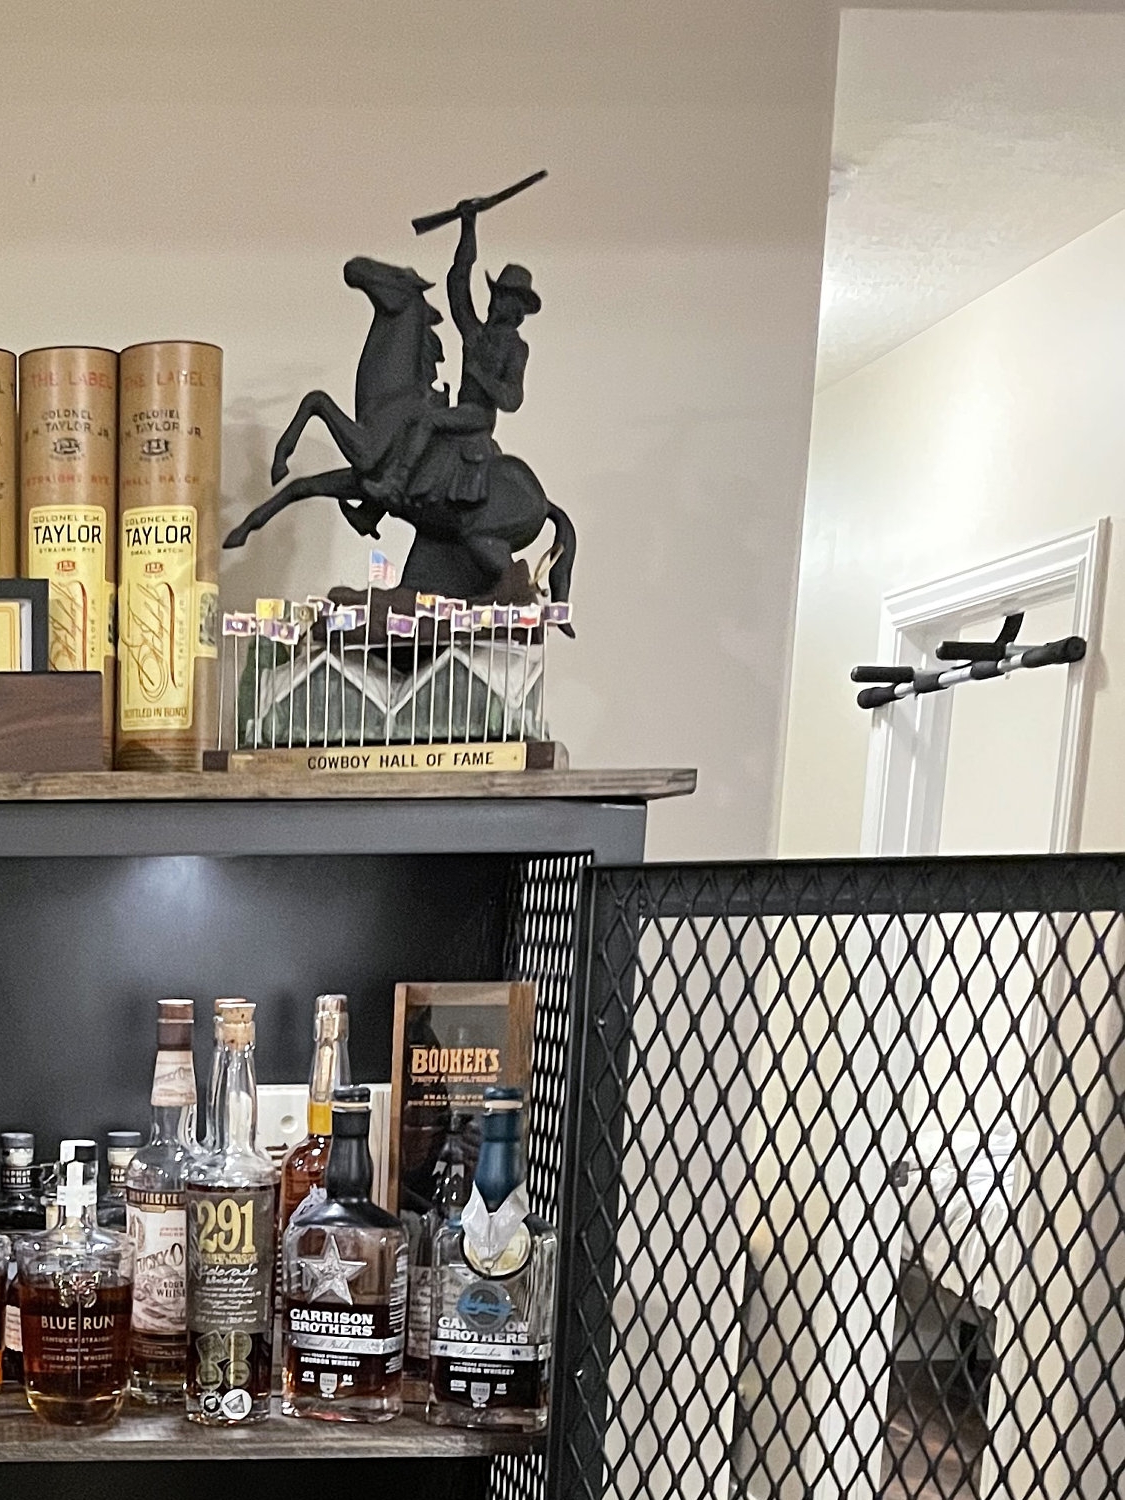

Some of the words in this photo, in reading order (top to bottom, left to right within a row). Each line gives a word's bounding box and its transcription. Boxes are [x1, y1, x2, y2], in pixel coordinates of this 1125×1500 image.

[33, 514, 79, 524] COLONEL
[125, 514, 168, 527] COLONEL
[33, 523, 102, 546] TAYLOR
[125, 525, 192, 548] TAYLOR
[307, 754, 372, 770] COWBOY
[379, 754, 419, 768] HALL
[426, 753, 445, 767] OF
[453, 751, 495, 766] FAME
[411, 1047, 500, 1074] BOOKER'S
[197, 1198, 256, 1254] 291
[41, 1315, 77, 1331] BLUE
[83, 1315, 115, 1331] RUN
[289, 1308, 374, 1326] GARRISON
[290, 1320, 373, 1337] BROTHERS
[437, 1327, 529, 1344] BROTHERS
